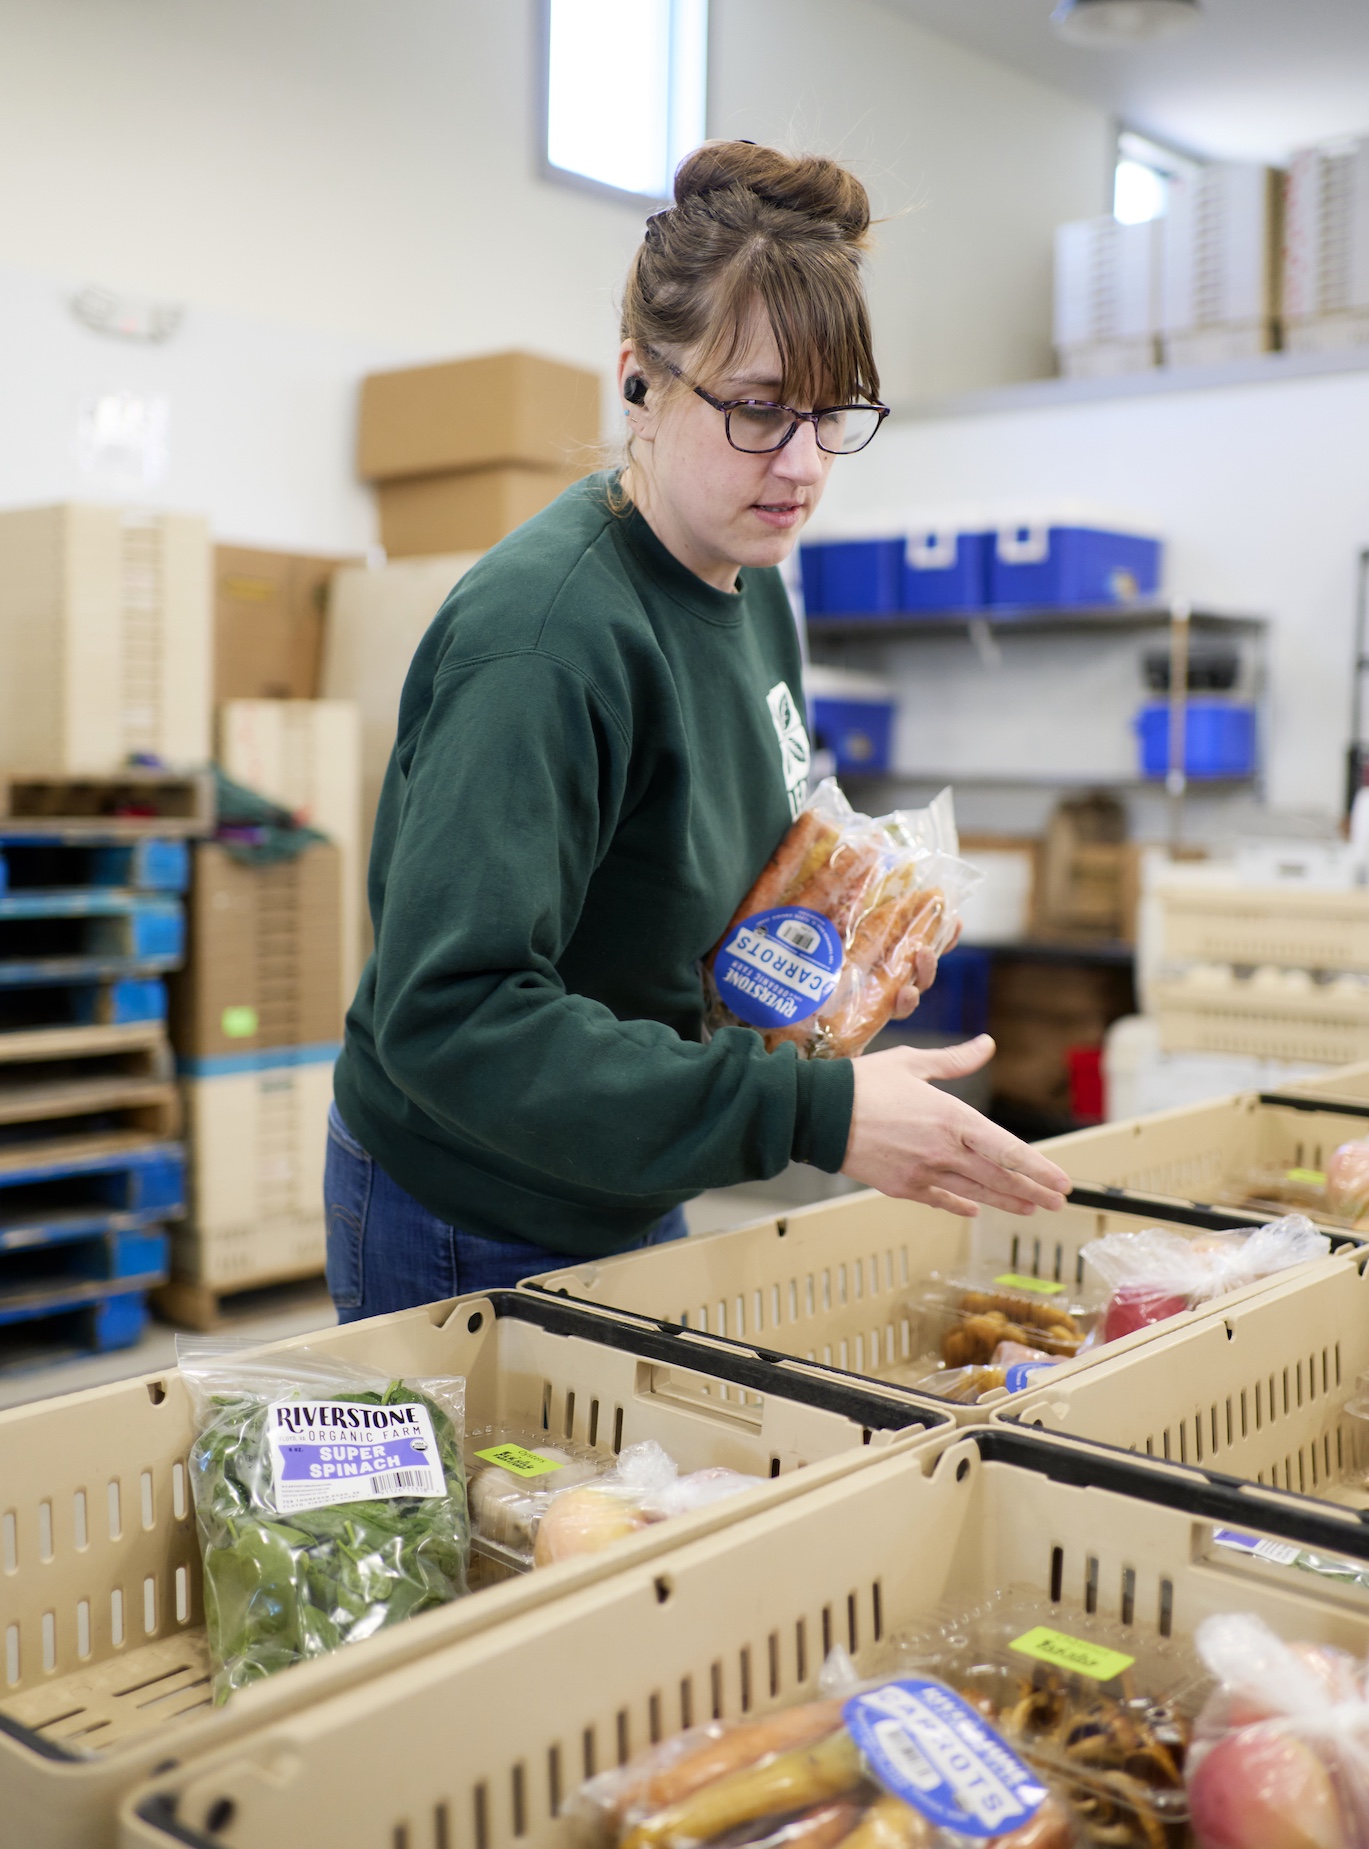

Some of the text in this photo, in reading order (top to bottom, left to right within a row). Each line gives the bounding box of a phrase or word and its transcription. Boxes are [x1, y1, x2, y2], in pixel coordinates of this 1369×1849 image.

[737, 936, 822, 990] CARROTS
[722, 967, 798, 1018] RIVERSTONE
[753, 972, 790, 998] ORGANIC
[276, 1406, 419, 1434] RIVERSTONE
[308, 1426, 421, 1443] ORGANIC FARM
[320, 1445, 386, 1462] SUPER
[309, 1455, 401, 1479] SPINACH
